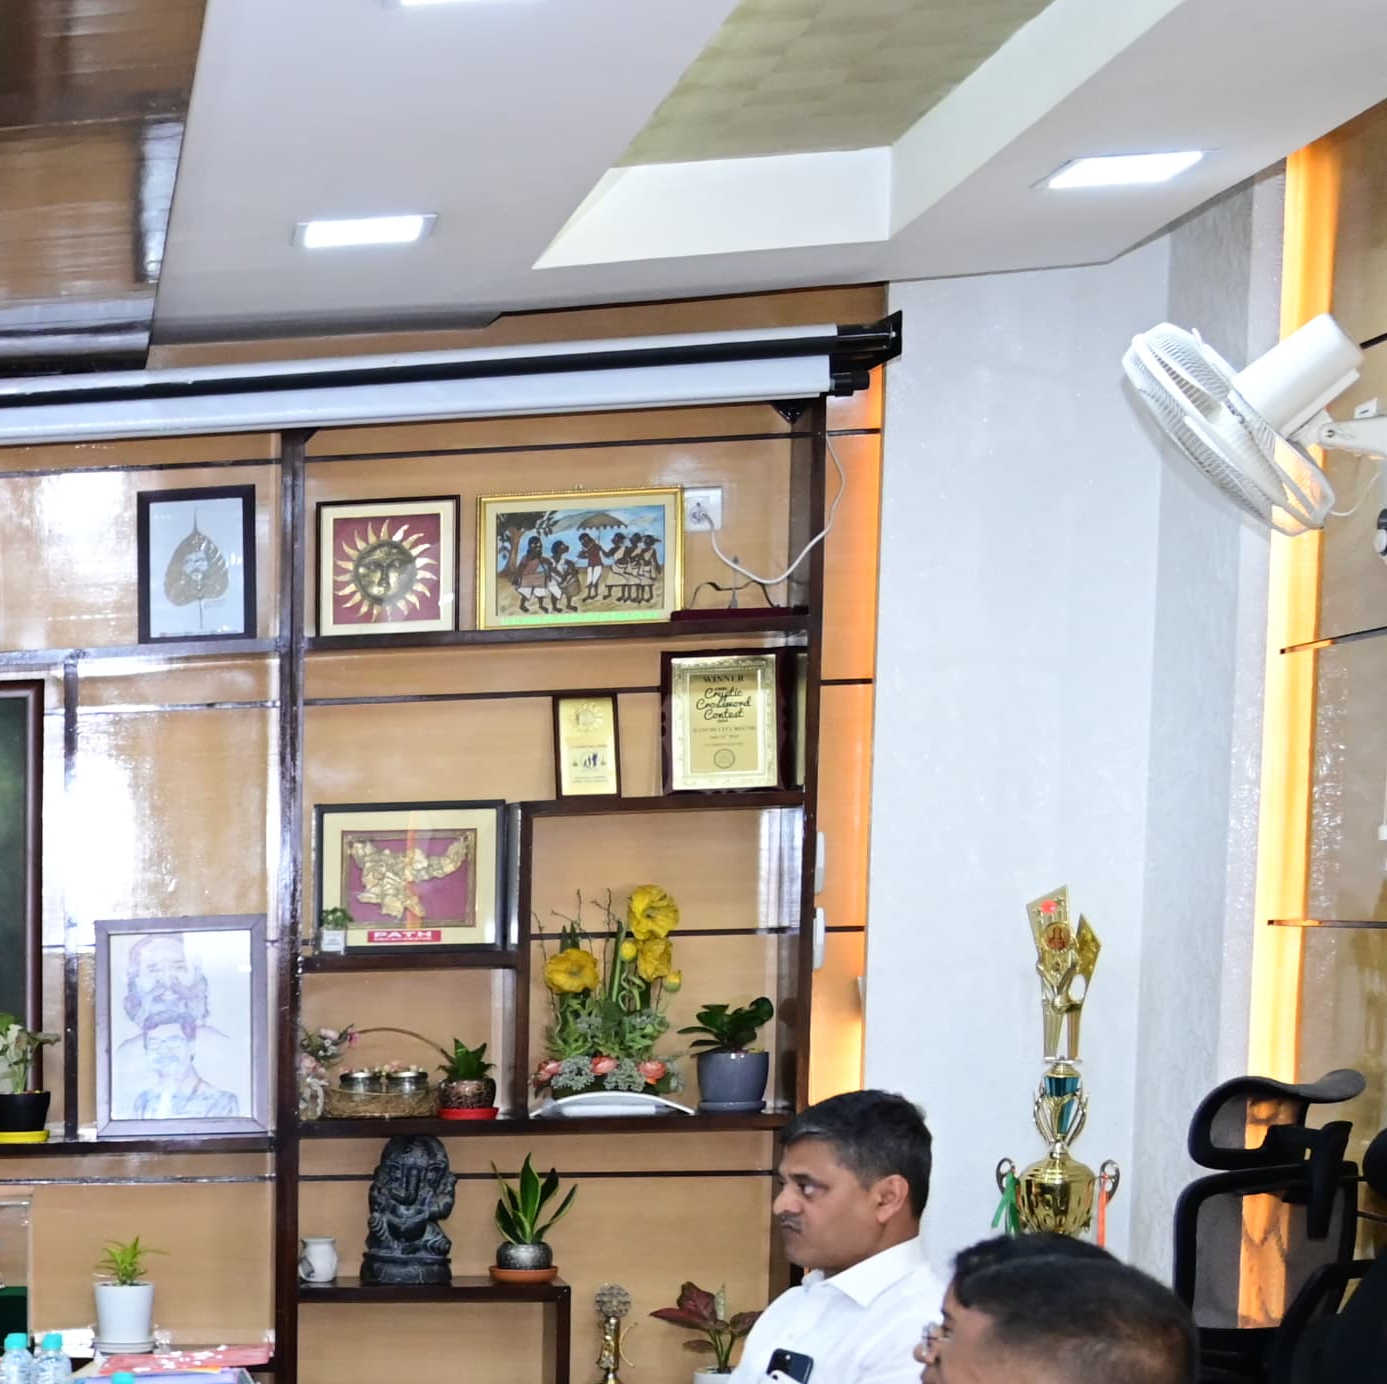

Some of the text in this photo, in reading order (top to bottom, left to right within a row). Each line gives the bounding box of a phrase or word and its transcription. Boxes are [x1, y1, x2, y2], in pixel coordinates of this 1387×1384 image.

[703, 674, 745, 683] WINNER
[704, 686, 743, 703] Cryptic
[696, 695, 752, 710] Crossword
[704, 708, 744, 720] Contest
